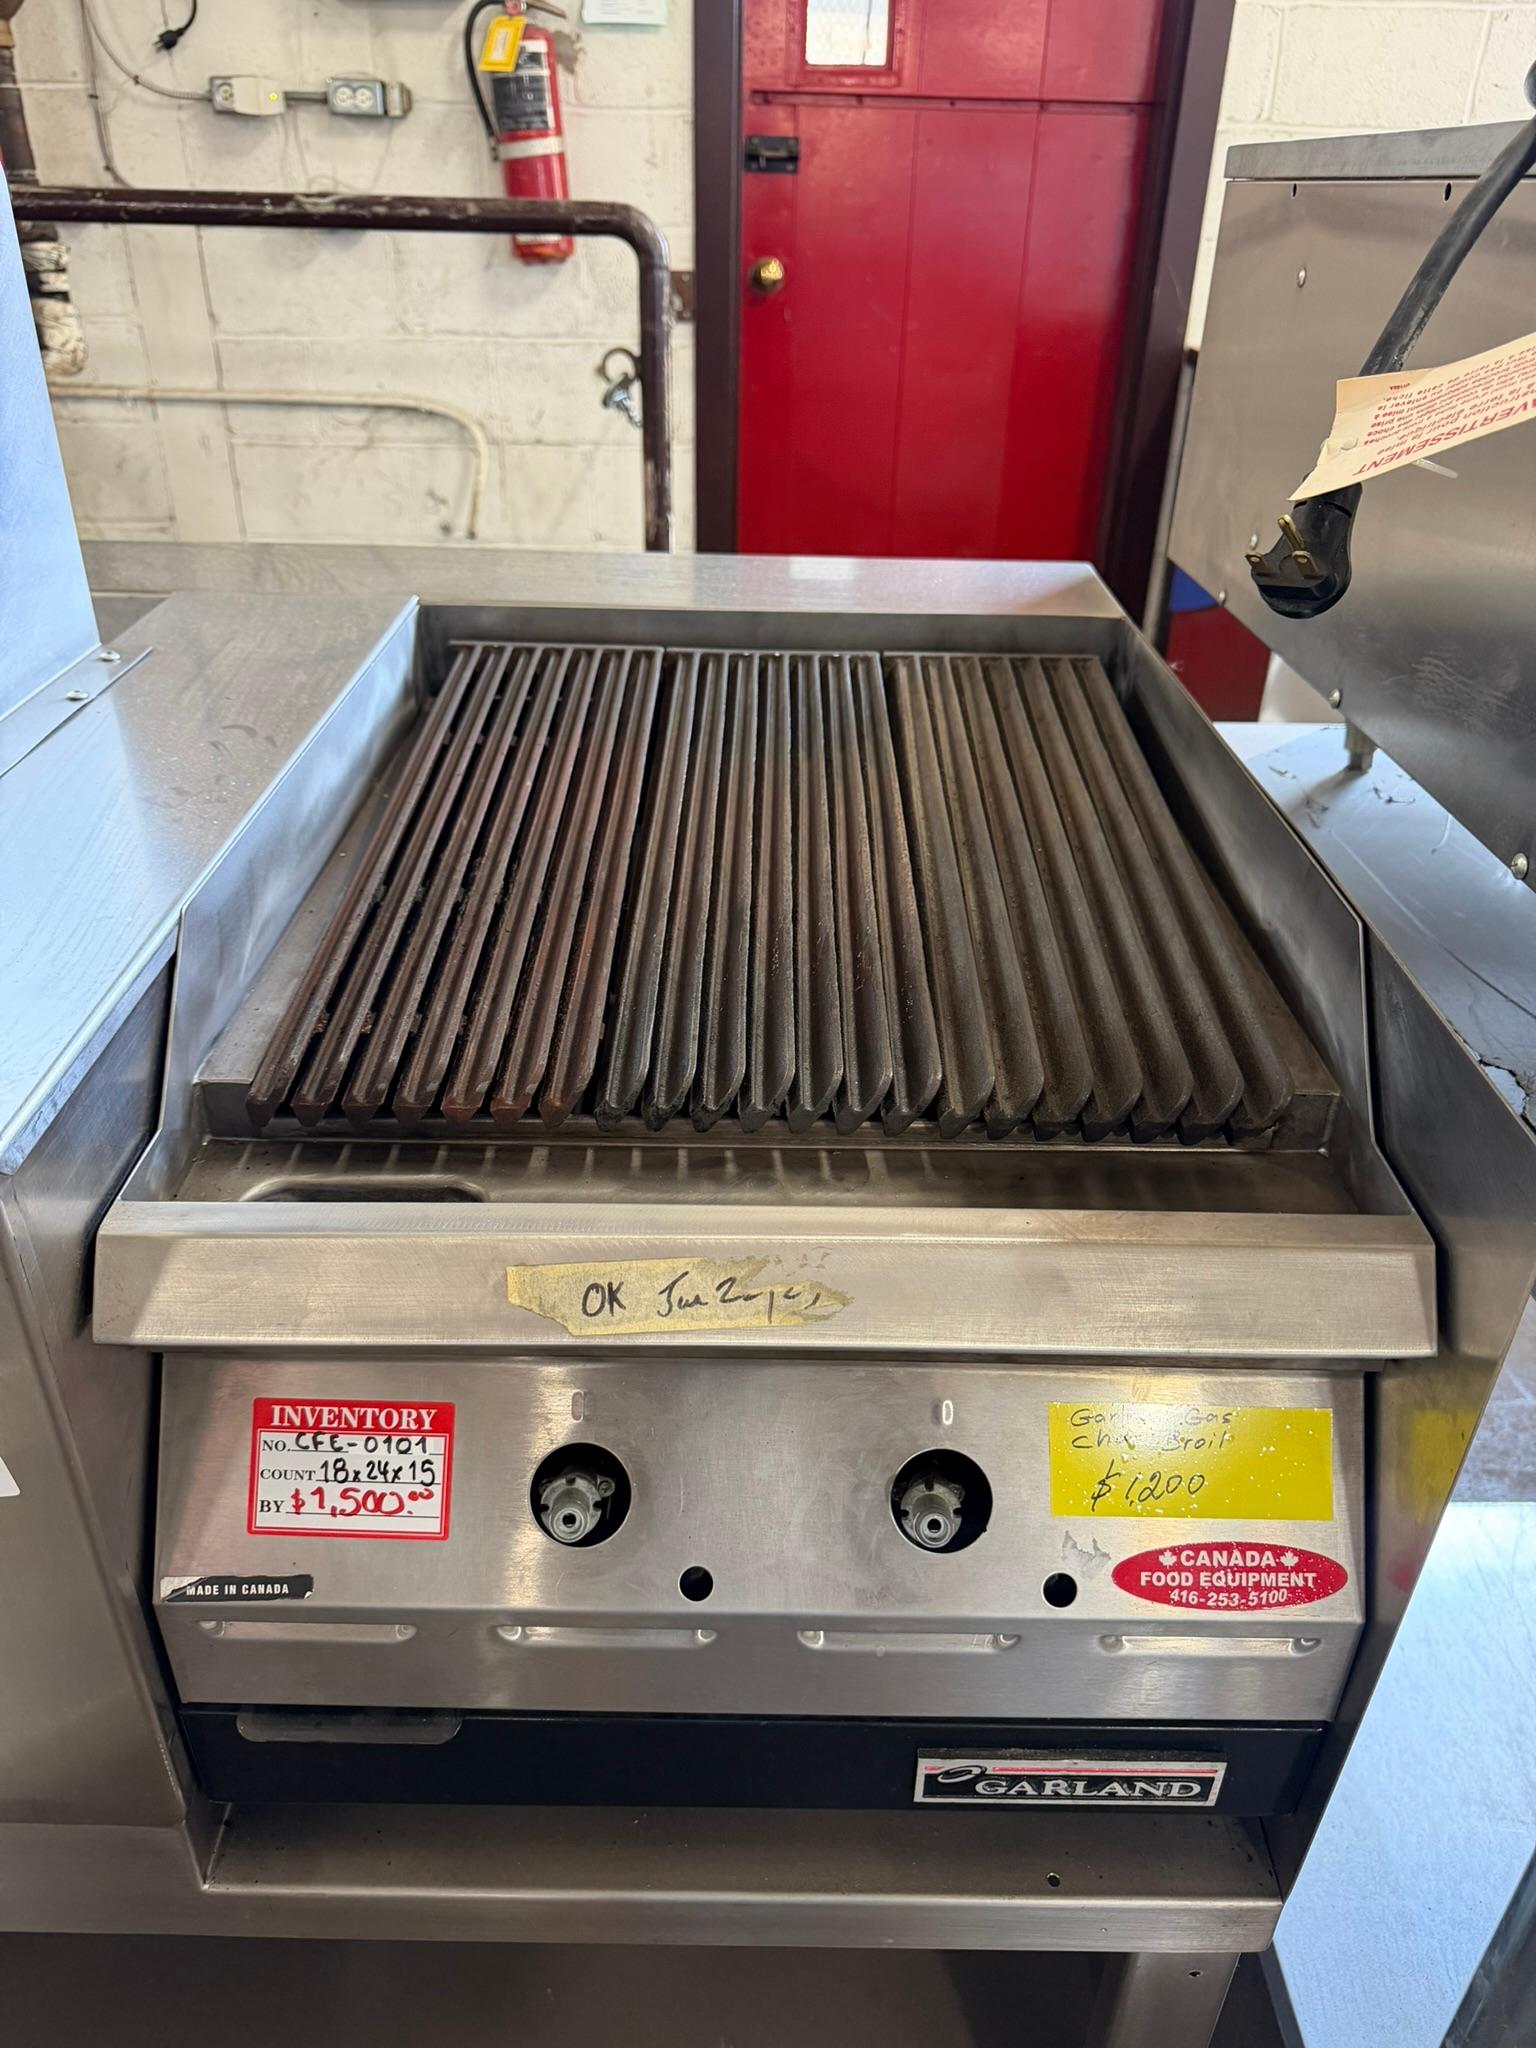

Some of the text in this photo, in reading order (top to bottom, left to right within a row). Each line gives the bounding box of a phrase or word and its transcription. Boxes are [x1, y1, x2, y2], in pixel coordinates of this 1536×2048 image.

[1352, 399, 1536, 476] VERTISSEMENT
[581, 1281, 627, 1317] OK
[271, 1404, 437, 1430] INVENTORY
[1184, 1408, 1233, 1427] Gas
[262, 1431, 429, 1454] NO. CFE-0101
[260, 1468, 316, 1481] COUNT
[1091, 1458, 1206, 1512] $1,200
[259, 1500, 285, 1513] BY
[1180, 1551, 1277, 1567] CANADA
[1140, 1571, 1317, 1588] FOOD EQUIPMENT
[186, 1583, 289, 1596] MADE IN CANADA
[1170, 1588, 1288, 1607] 416-253-5100
[974, 1779, 1201, 1798] GARLAND
